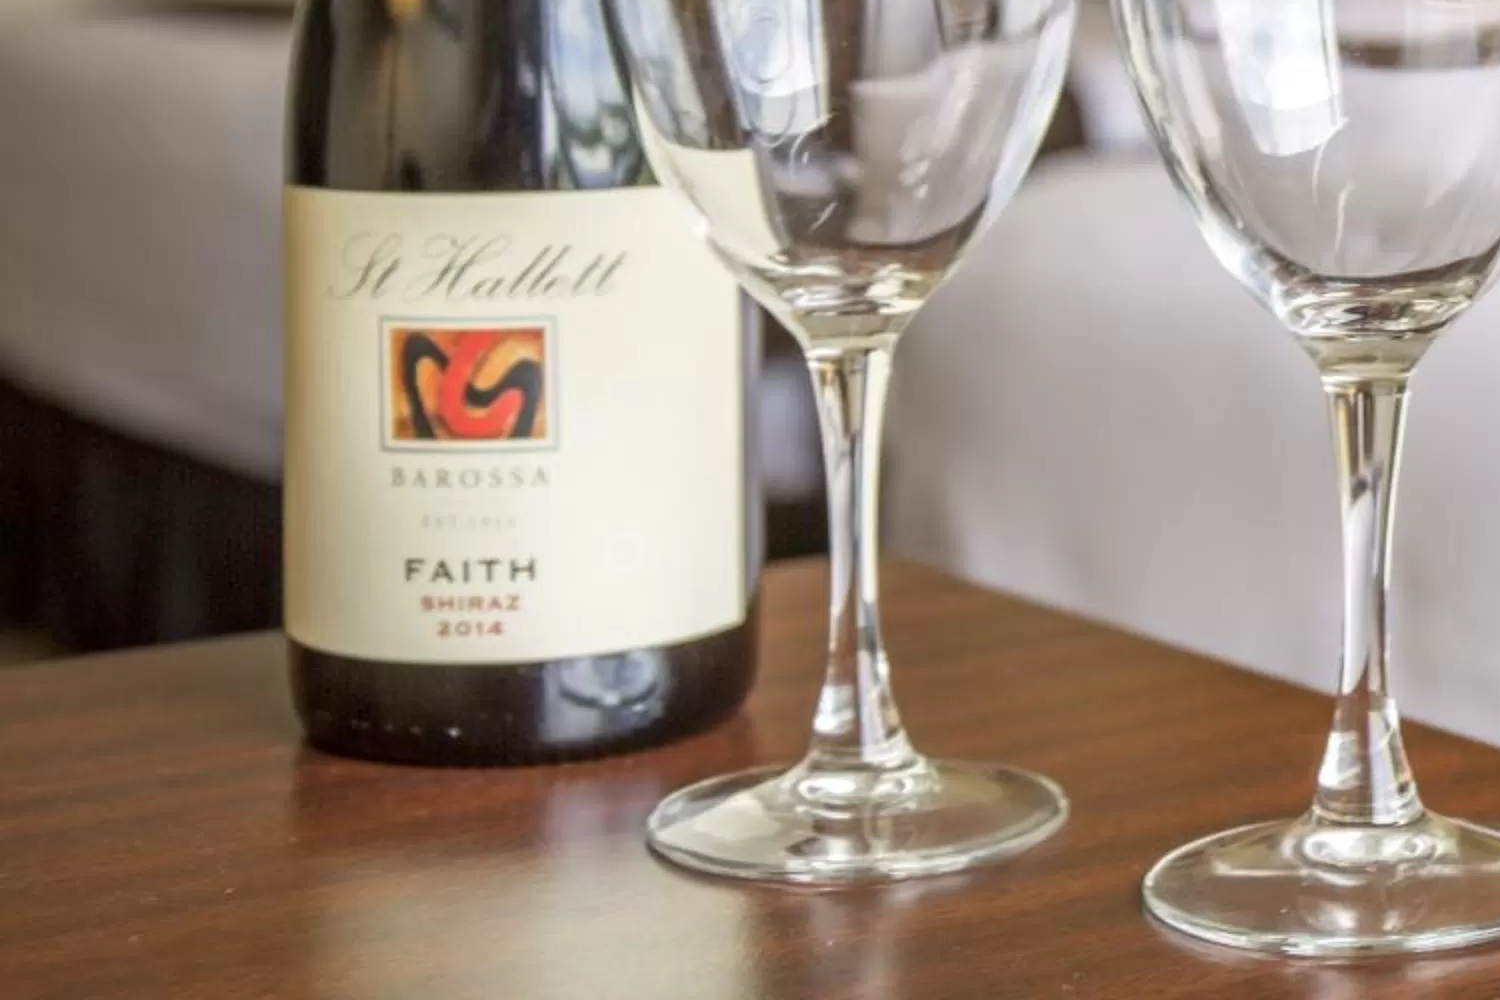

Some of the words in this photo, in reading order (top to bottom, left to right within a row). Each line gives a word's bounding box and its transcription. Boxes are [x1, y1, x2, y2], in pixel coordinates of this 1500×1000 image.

[326, 231, 405, 301] St
[402, 231, 629, 304] Hallett
[390, 465, 551, 489] BAROSSA
[403, 556, 538, 584] FAITH
[420, 593, 521, 613] SHIRAZ
[436, 619, 505, 639] 2014
